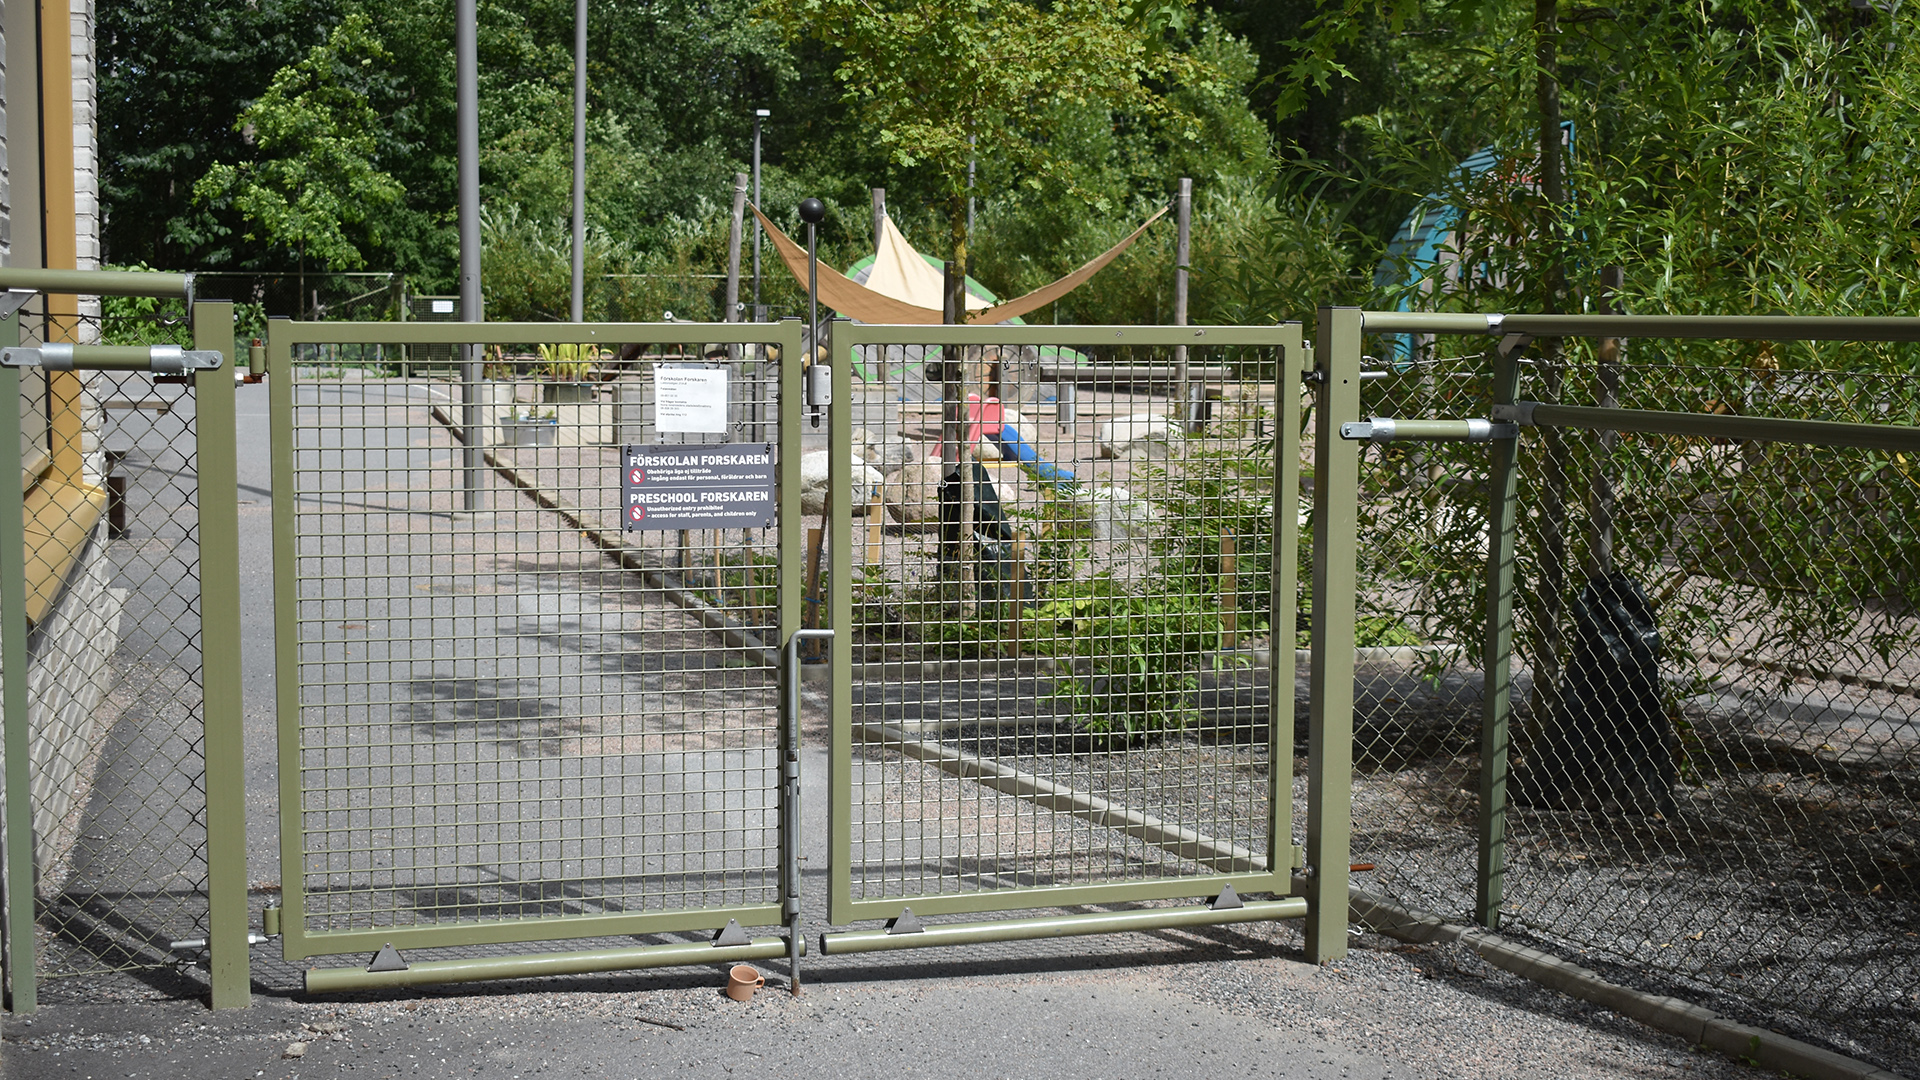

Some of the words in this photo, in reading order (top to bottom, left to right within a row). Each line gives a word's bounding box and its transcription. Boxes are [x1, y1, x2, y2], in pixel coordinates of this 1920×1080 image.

[630, 454, 699, 467] FÖRSKOLAN
[701, 454, 769, 466] FORSKAREN
[651, 474, 669, 482] ingång
[630, 492, 699, 504] PRESCHOOL
[700, 491, 769, 502] FORSKAREN
[691, 511, 714, 519] parents,
